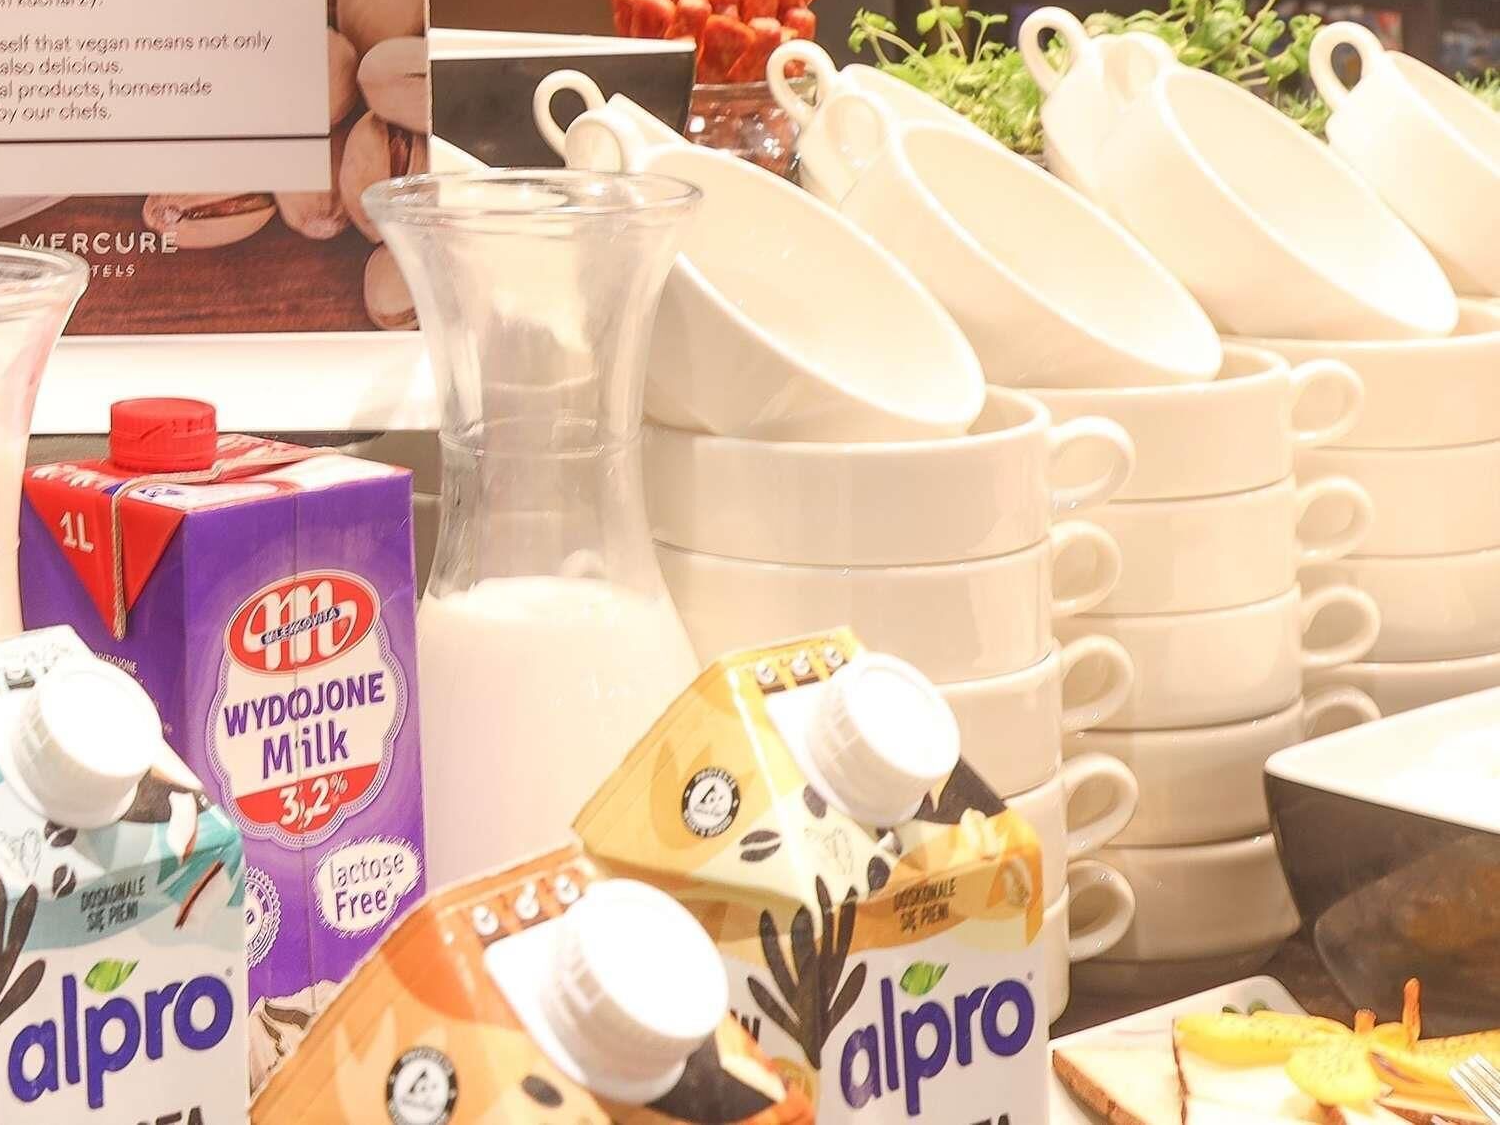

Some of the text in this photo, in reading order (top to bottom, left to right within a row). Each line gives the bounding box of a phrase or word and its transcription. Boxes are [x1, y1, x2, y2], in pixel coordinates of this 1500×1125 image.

[35, 35, 71, 52] that
[77, 36, 130, 55] vegan
[134, 36, 194, 52] means
[199, 33, 229, 50] not
[234, 30, 273, 52] only
[0, 57, 34, 75] also
[18, 79, 105, 104] products,
[108, 77, 213, 96] homemade
[22, 106, 55, 121] our
[19, 230, 179, 255] MERCURE
[90, 263, 136, 278] TELS
[59, 511, 94, 554] 1L
[223, 672, 385, 738] WYDOJONE
[262, 720, 350, 780] Milk
[279, 773, 349, 827] 3,2%
[329, 851, 405, 889] lactose
[334, 888, 389, 923] Free
[8, 973, 234, 1110] alpro
[840, 977, 1035, 1117] alpro
